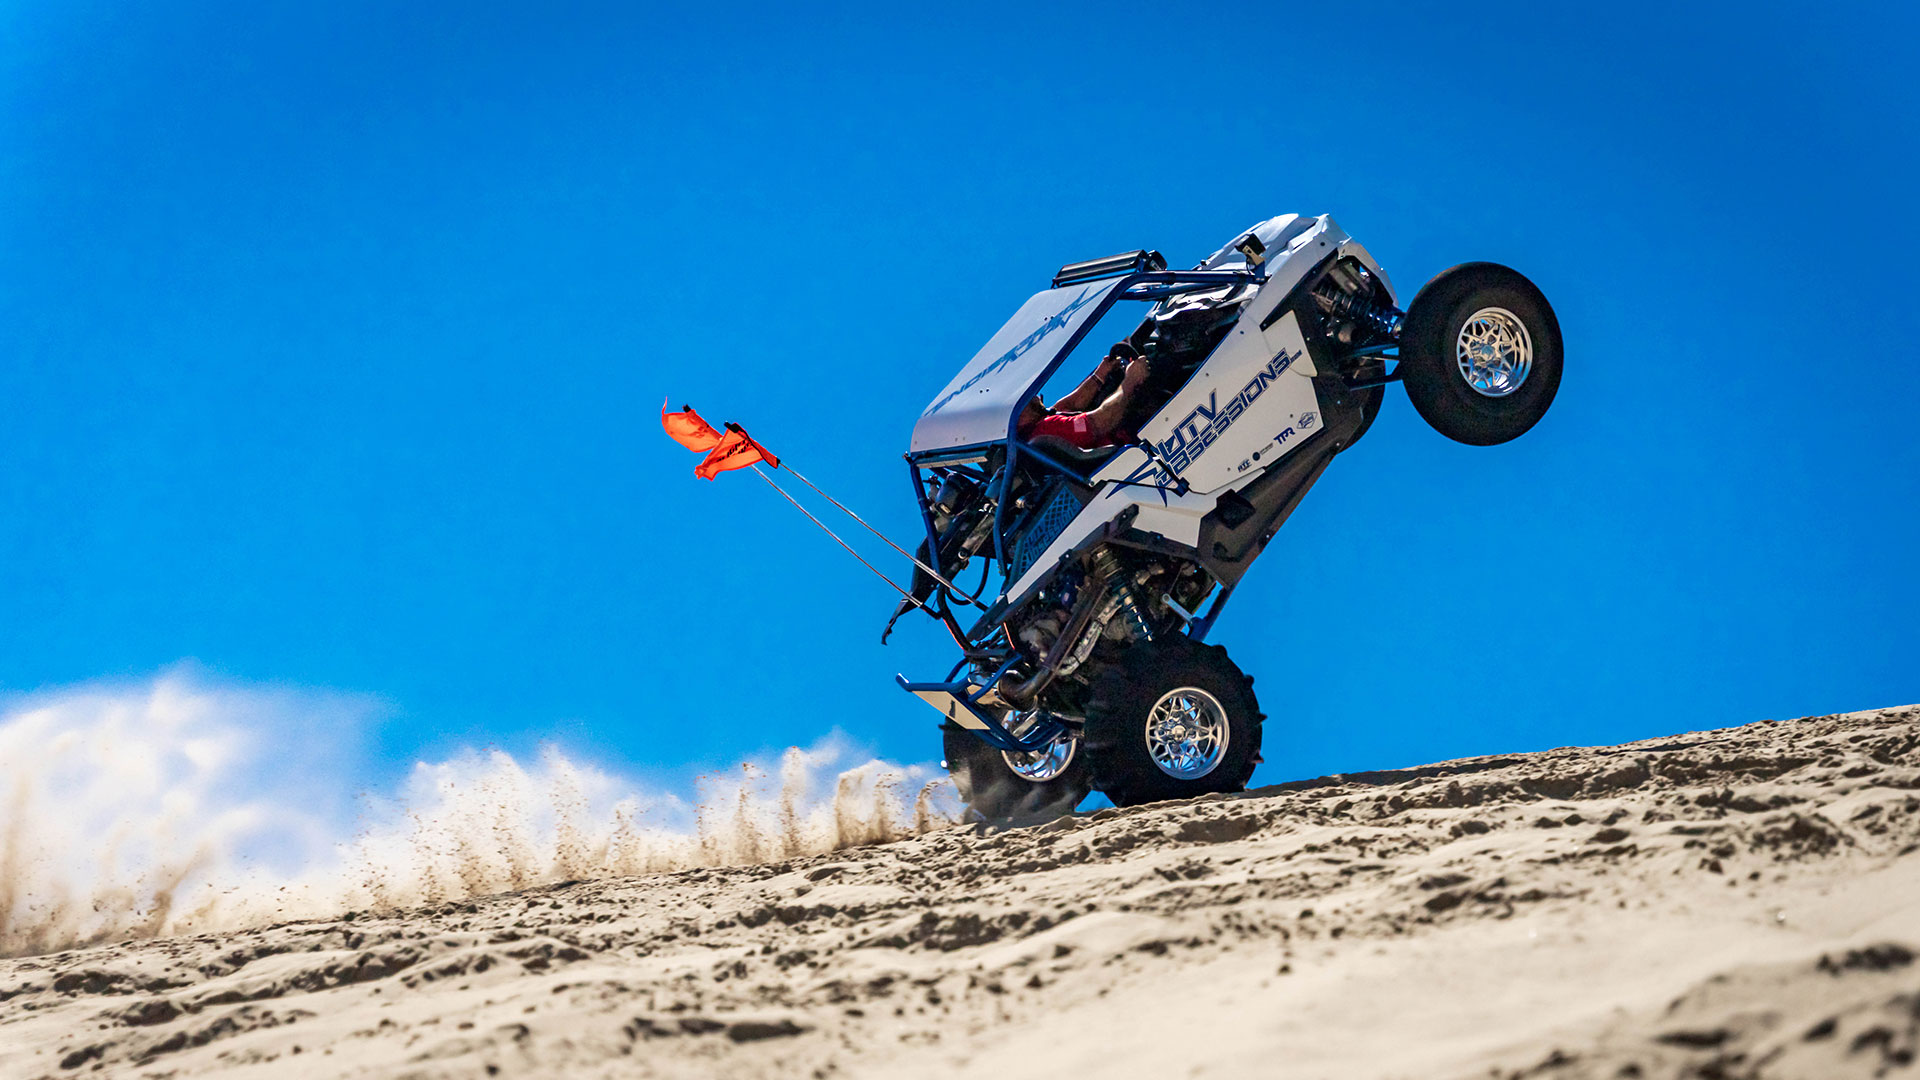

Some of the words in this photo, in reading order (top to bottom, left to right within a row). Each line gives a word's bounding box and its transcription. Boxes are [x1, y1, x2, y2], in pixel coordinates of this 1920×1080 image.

[1155, 347, 1291, 488] OBSESSIONS
[1156, 388, 1217, 463] UTV
[1273, 427, 1296, 445] TPR
